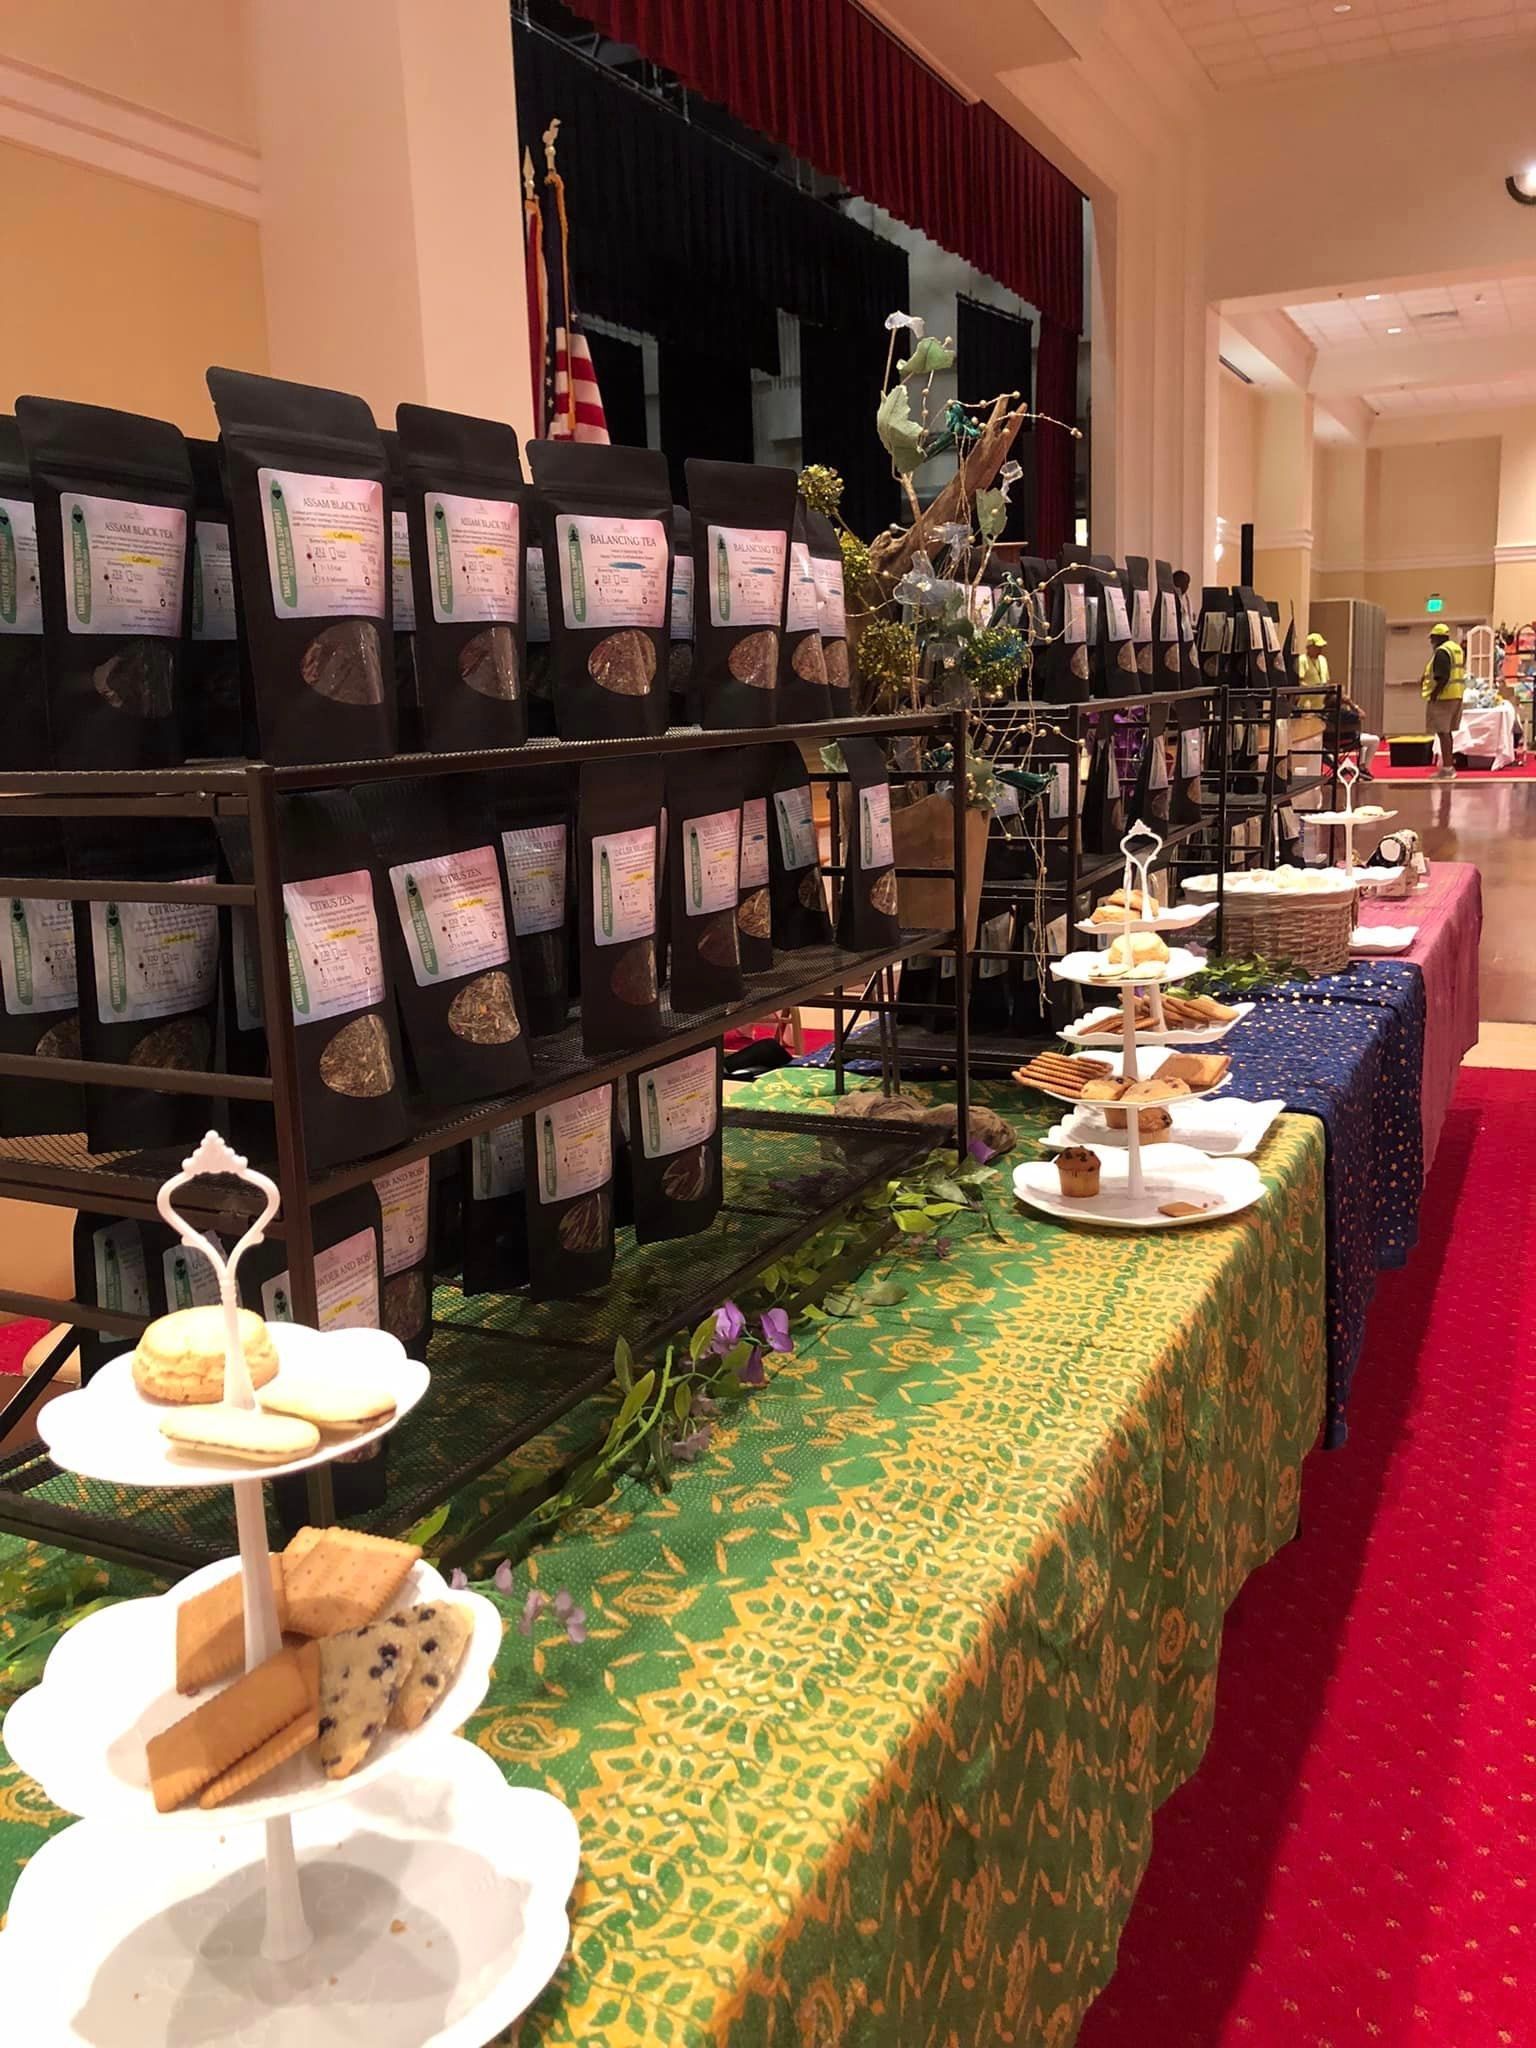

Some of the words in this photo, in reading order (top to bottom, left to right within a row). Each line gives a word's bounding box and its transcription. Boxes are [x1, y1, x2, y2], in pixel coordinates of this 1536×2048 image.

[304, 497, 330, 509] ASSAM
[331, 500, 356, 512] BLACK
[104, 522, 131, 534] ASSAM
[132, 525, 158, 537] BLACK
[159, 528, 174, 539] TEA
[590, 534, 640, 546] BALANCING
[640, 536, 656, 547] TEA
[439, 872, 466, 884] CITRUS
[467, 868, 482, 878] ZEN
[310, 897, 338, 912] CITRUS
[338, 894, 354, 906] ZEN
[392, 1174, 408, 1184] AND
[340, 1260, 356, 1274] AND
